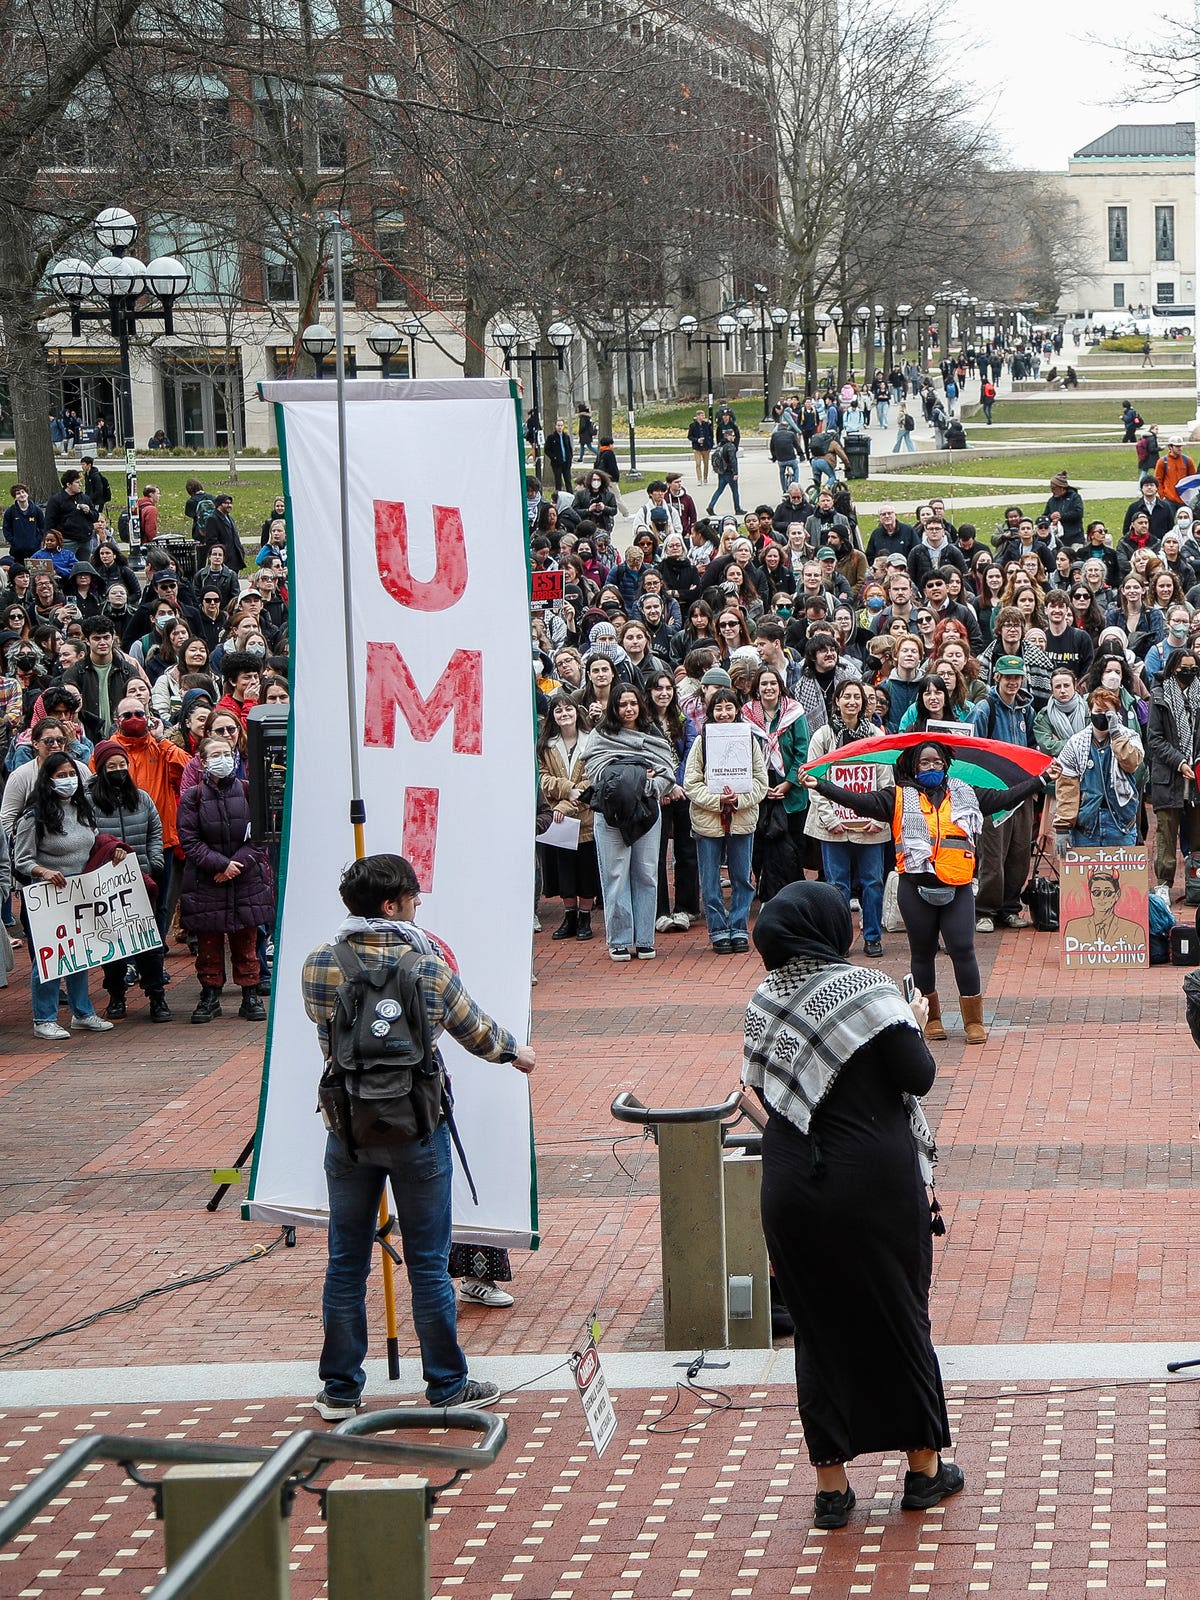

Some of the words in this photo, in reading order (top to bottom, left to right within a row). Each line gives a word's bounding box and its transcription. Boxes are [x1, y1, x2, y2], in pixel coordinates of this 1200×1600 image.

[532, 572, 562, 591] EST
[363, 499, 484, 976] UMI
[835, 766, 875, 781] DIVEST
[28, 878, 86, 912] STEM
[93, 864, 137, 898] demands
[56, 924, 66, 940] a
[74, 888, 139, 934] FREE
[39, 916, 162, 979] PALESTINE
